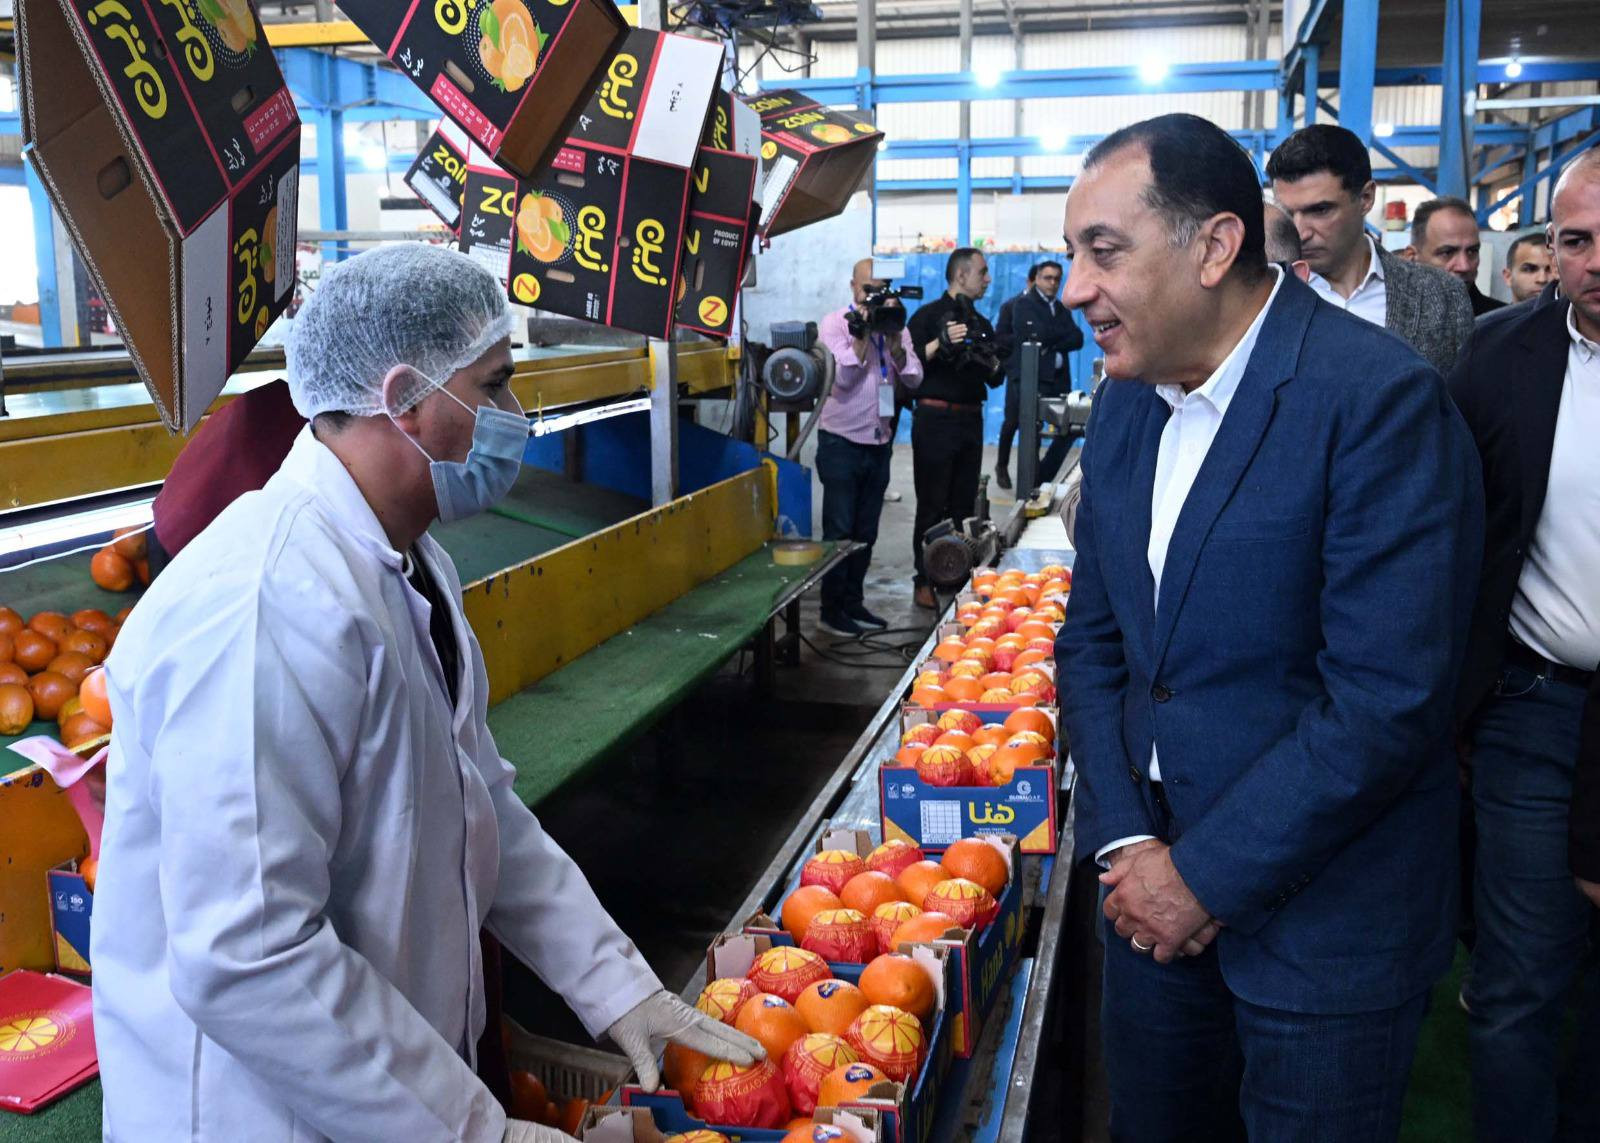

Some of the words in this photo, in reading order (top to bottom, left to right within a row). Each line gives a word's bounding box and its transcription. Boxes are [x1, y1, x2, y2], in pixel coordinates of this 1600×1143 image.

[714, 229, 739, 241] PRODUCE
[721, 239, 738, 248] EGYPT
[703, 300, 721, 323] Z
[969, 801, 1015, 824] هنا
